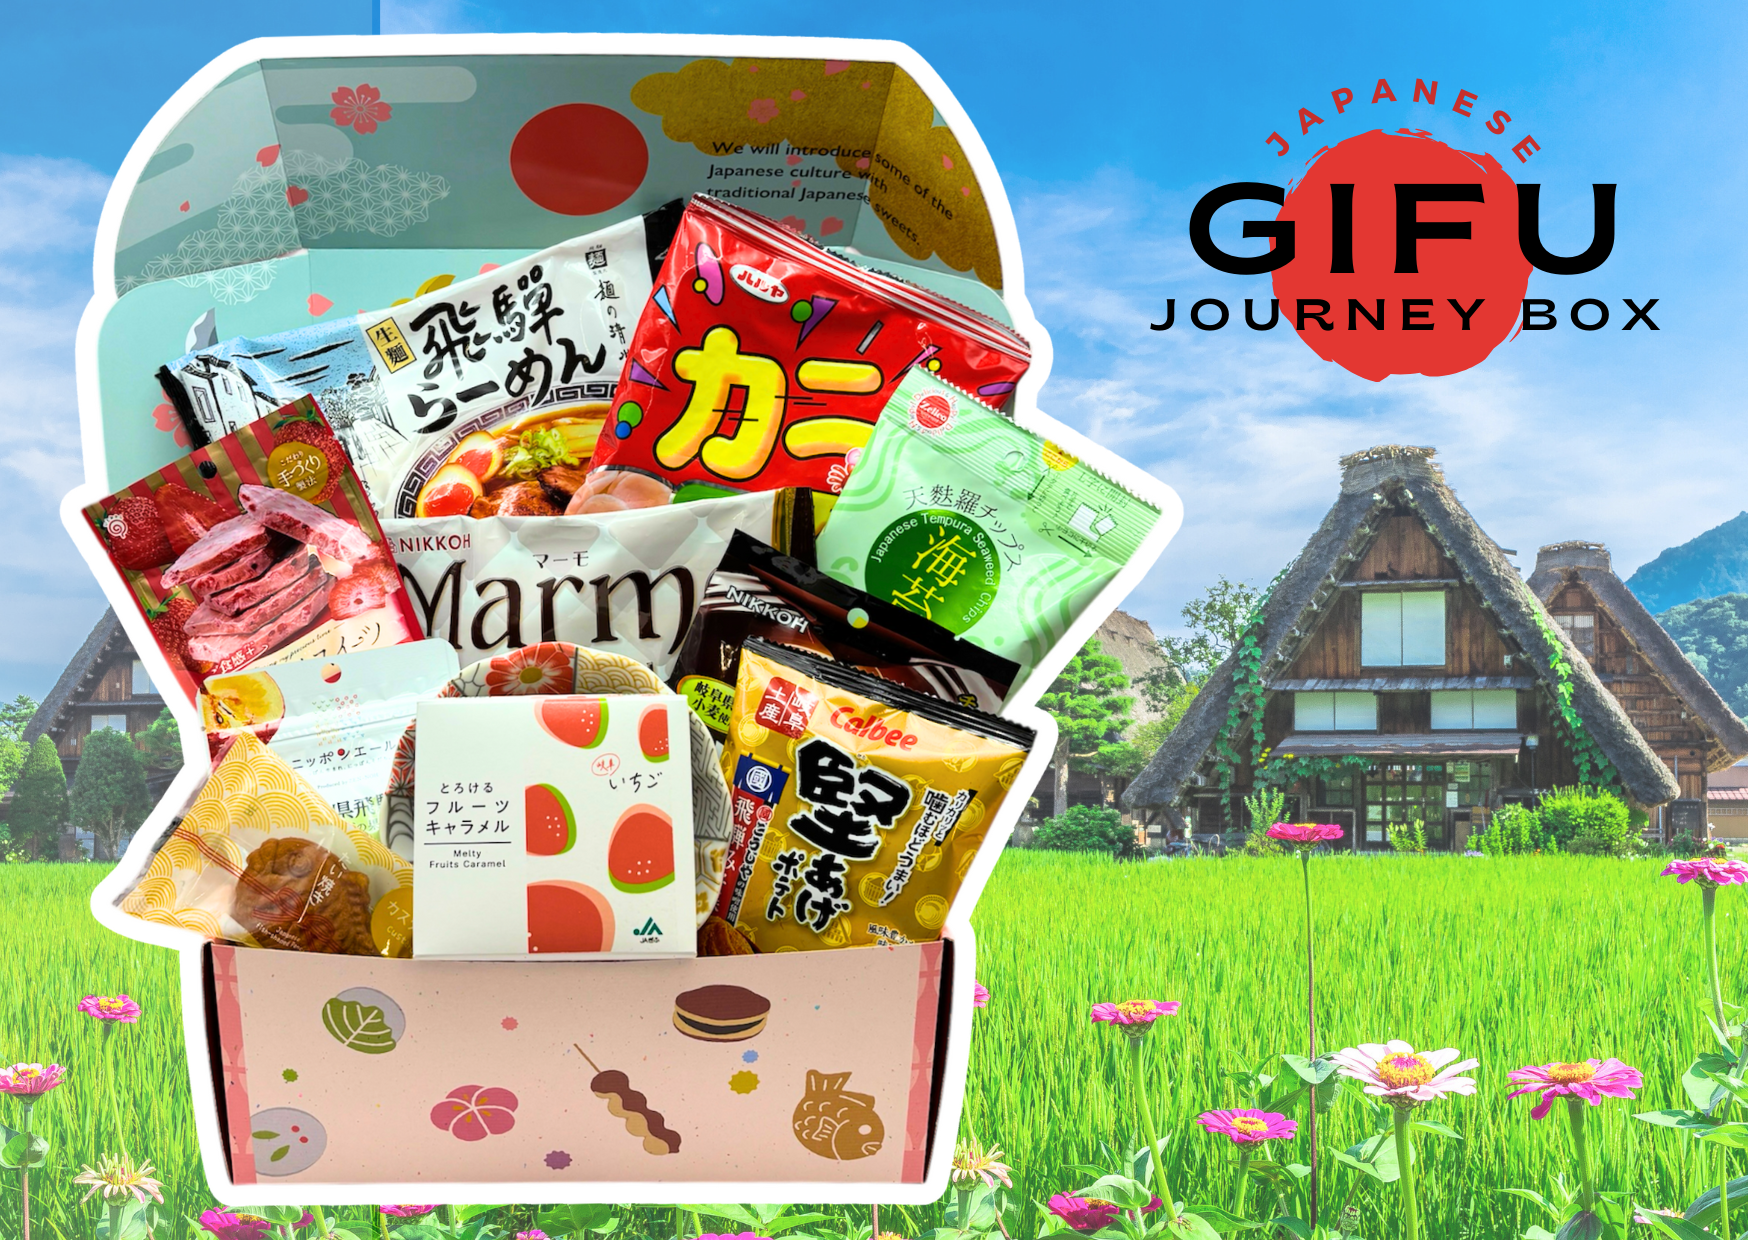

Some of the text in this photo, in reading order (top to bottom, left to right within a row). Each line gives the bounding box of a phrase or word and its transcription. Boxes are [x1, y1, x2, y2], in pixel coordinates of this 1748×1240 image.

[707, 164, 888, 193] Japanese culture with
[712, 141, 953, 220] We will introduce some of the
[707, 186, 920, 246] traditional Japanese sweets.
[407, 338, 606, 434] らーめん
[654, 324, 884, 480] カニ
[277, 454, 321, 488] 手づくり
[400, 533, 471, 553] NIKKOH
[533, 551, 590, 569] マーモ
[870, 512, 996, 624] Japanese Tempura Seaweed Chips
[726, 586, 809, 634] NIKKOH
[694, 681, 734, 711] 岐阜県
[759, 686, 787, 724] 土産
[830, 706, 918, 752] Calbee
[292, 740, 397, 770] ニッポンエール
[440, 782, 494, 794] とろける
[609, 772, 663, 793] いちご
[426, 800, 509, 815] フルーツ
[934, 790, 968, 840] カリカリッと
[426, 820, 510, 836] キャラメル
[429, 859, 506, 869] Fruits Caramel
[453, 849, 482, 859] Melty
[309, 852, 350, 907] たい焼き
[766, 850, 805, 921] ポテト
[387, 900, 413, 931] カス
